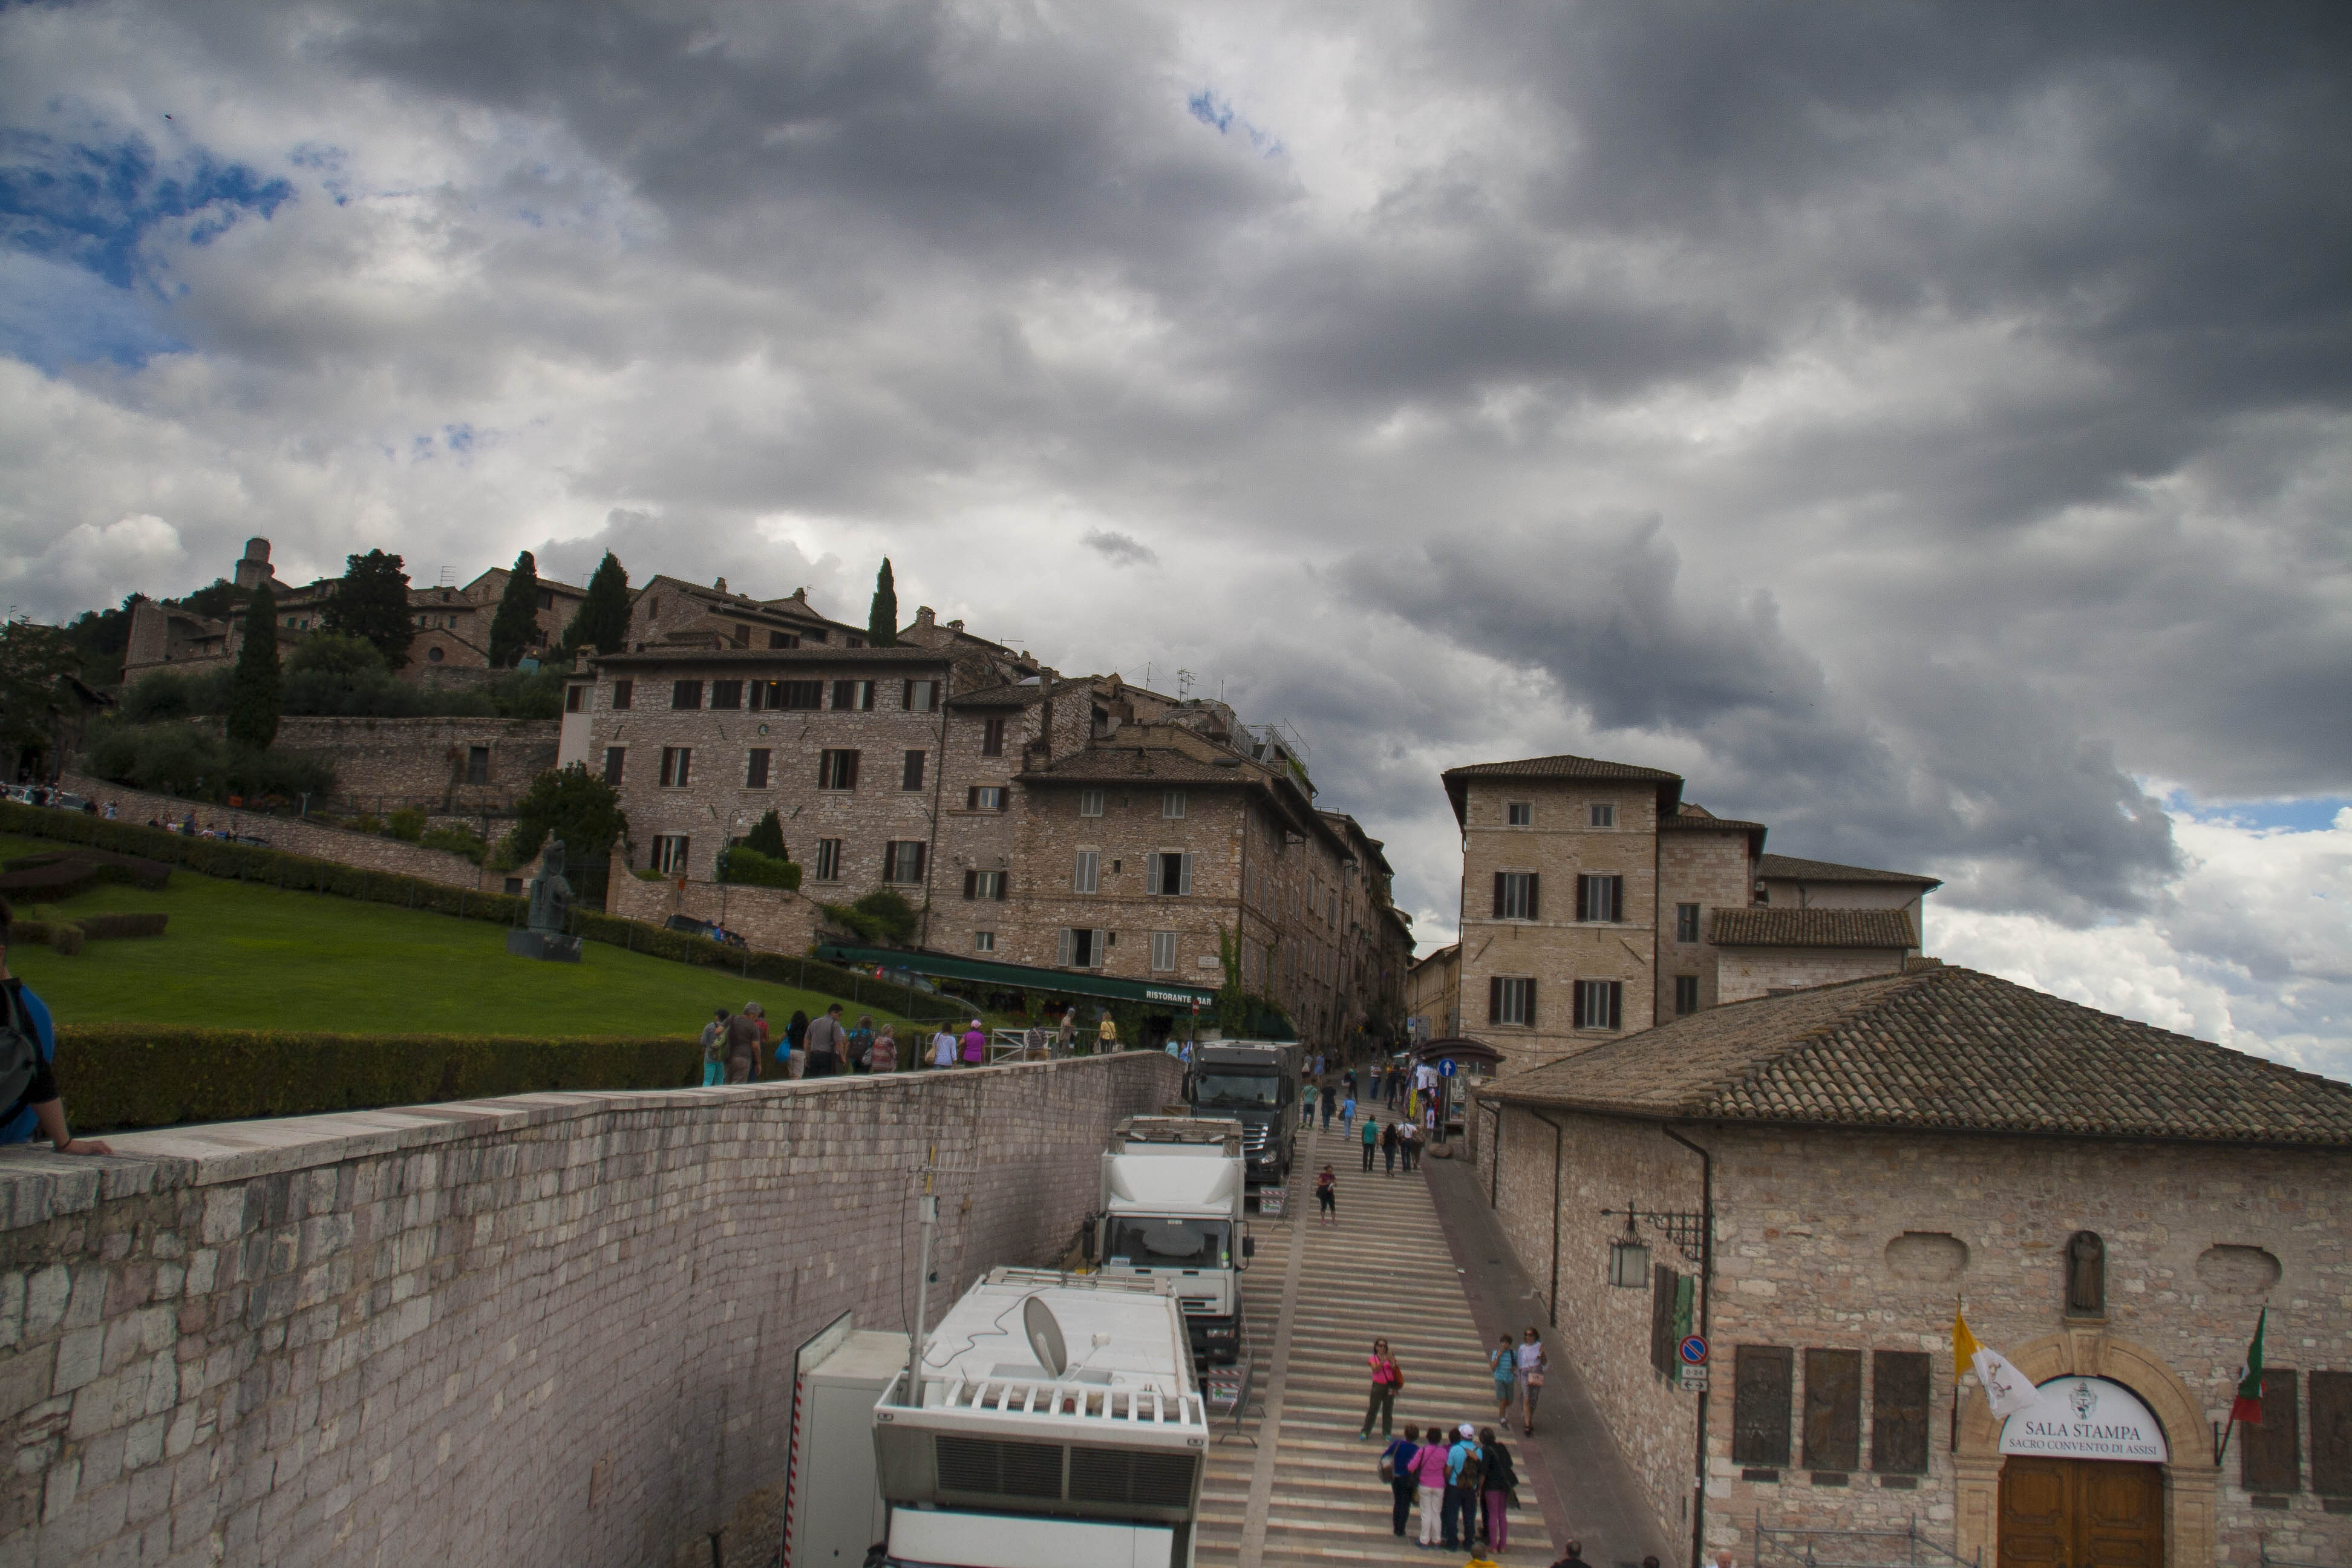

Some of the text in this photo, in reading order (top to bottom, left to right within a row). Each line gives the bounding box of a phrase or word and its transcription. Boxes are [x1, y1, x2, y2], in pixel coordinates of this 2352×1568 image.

[1146, 991, 1212, 1006] RISTORANTE BAR
[2025, 1421, 2141, 1440] SALA STAMPA
[2009, 1439, 2157, 1455] SACRO CONVENTO DI ASSISI
